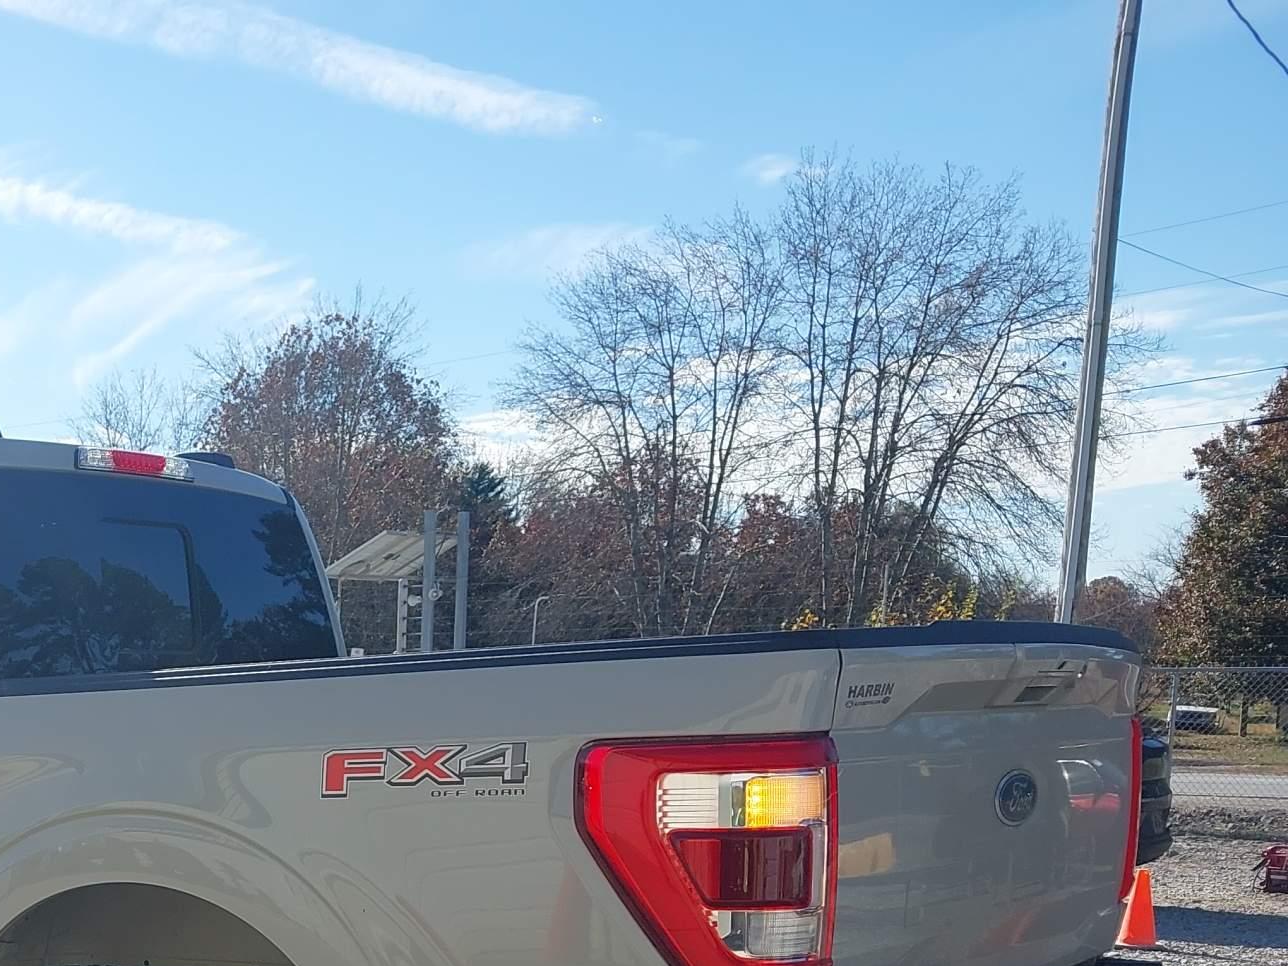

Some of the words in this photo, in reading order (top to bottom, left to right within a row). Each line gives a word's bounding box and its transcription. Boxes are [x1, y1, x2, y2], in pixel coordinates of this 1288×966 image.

[848, 682, 895, 698] HARBIN
[320, 741, 528, 799] FX4
[430, 789, 468, 798] OFF
[475, 788, 525, 797] ROAD
